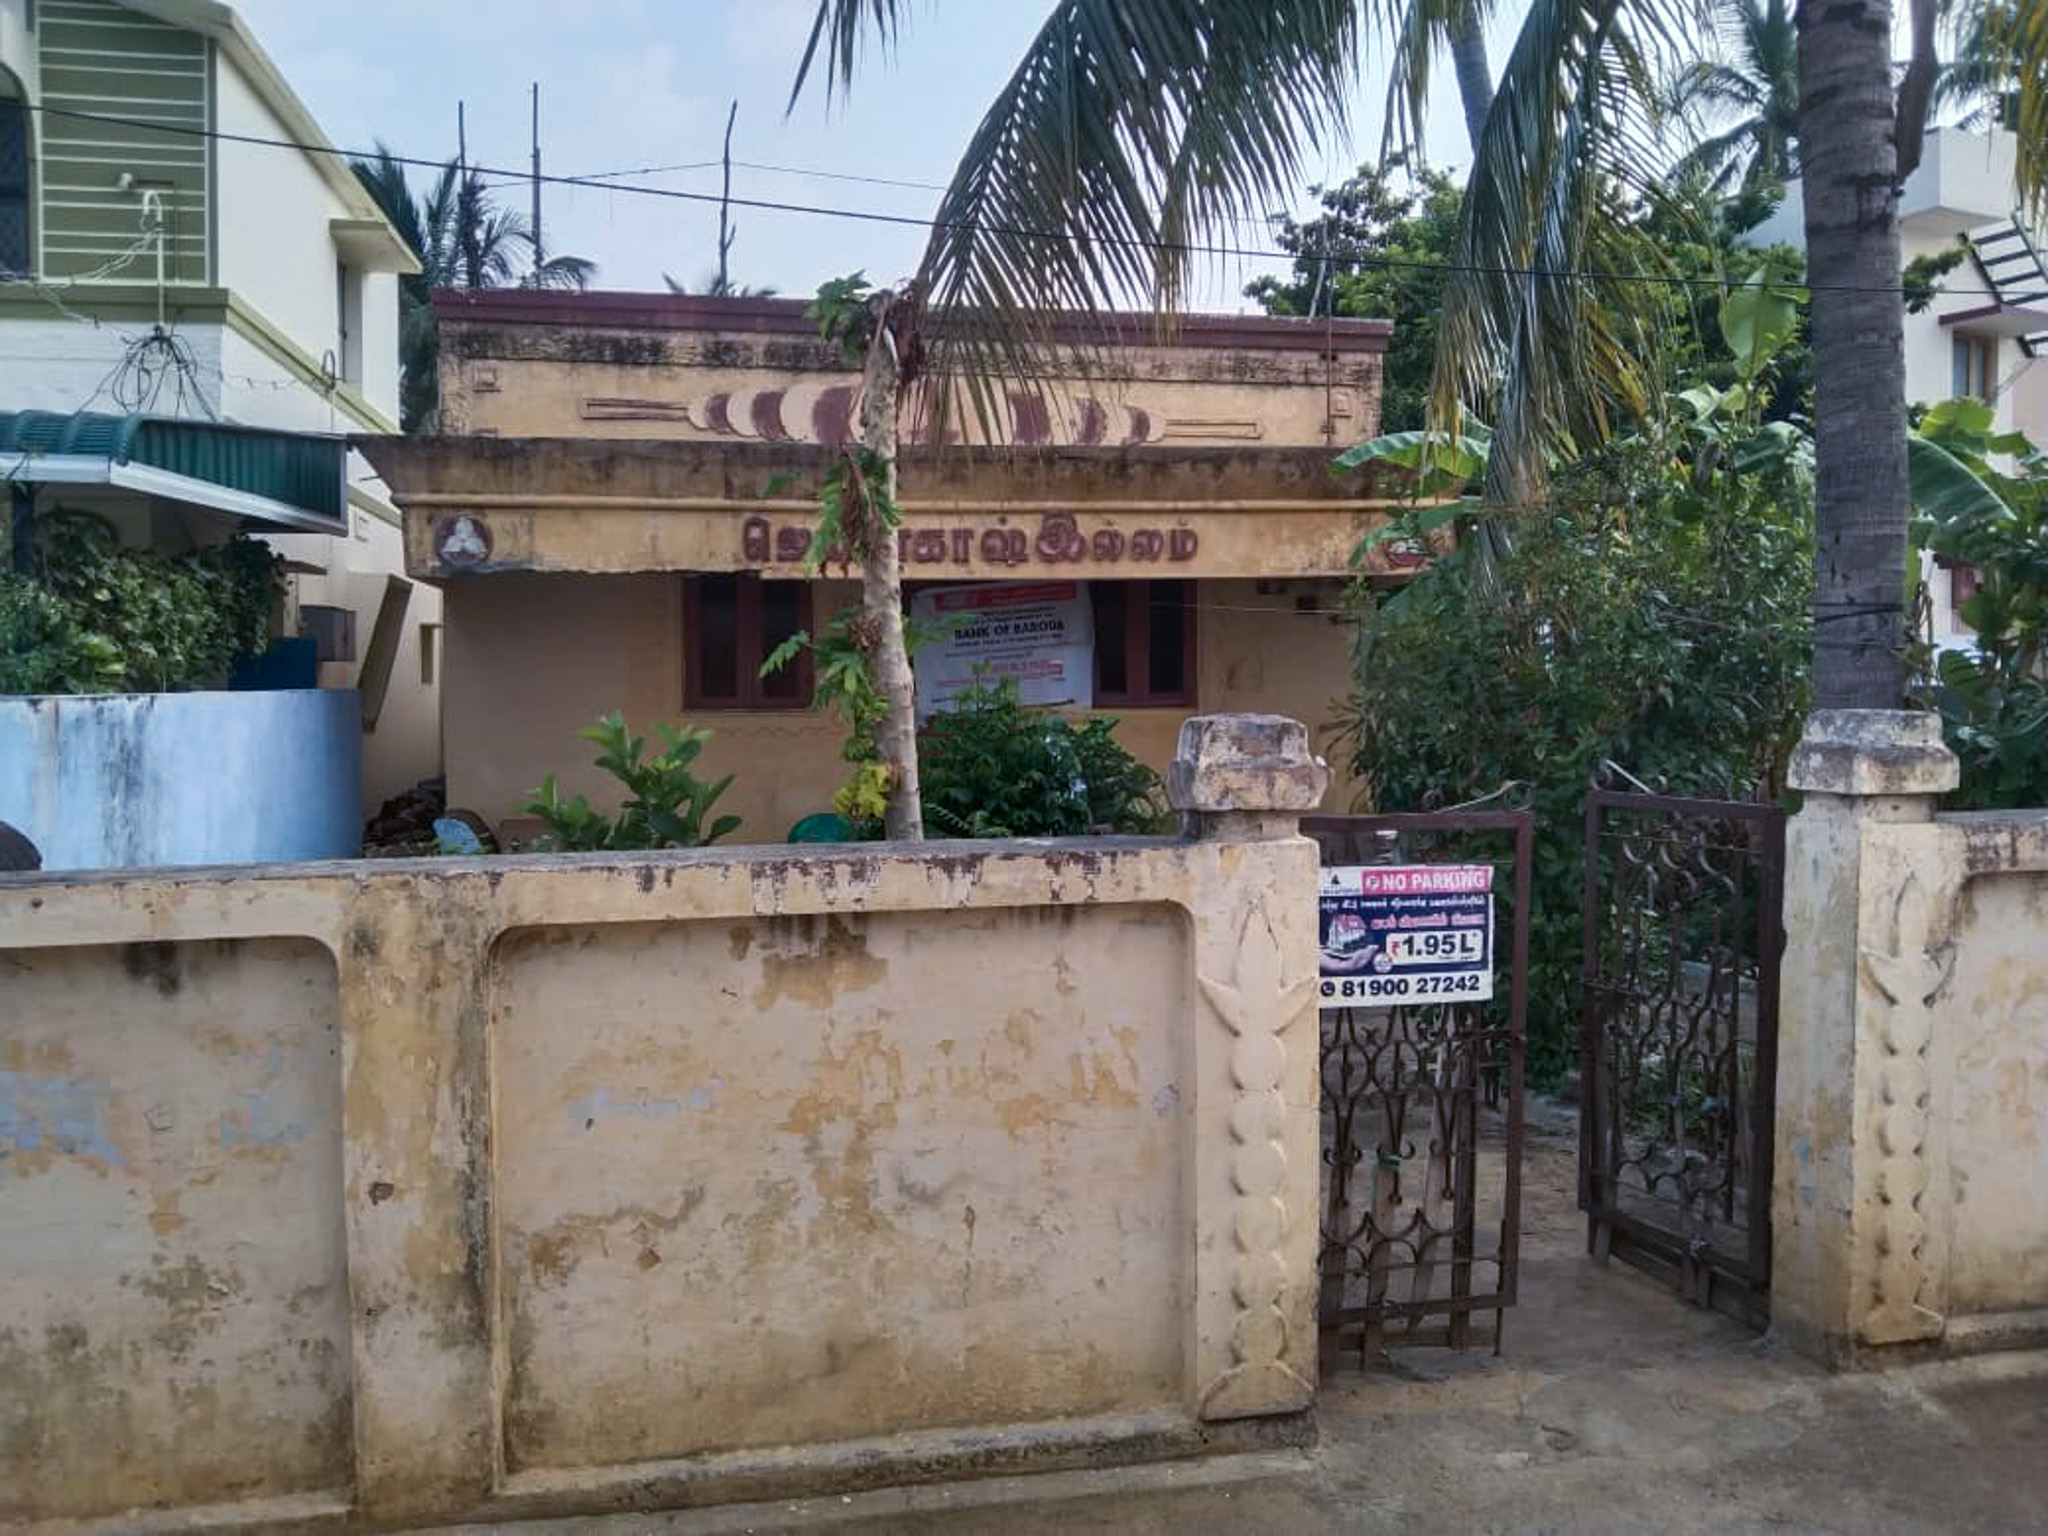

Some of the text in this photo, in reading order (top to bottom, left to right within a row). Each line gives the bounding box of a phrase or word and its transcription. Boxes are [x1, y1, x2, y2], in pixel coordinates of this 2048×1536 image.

[954, 619, 1065, 641] BANK OF BARODA
[1382, 871, 1485, 890] NO PARKING
[1341, 974, 1480, 997] 81900 27242
